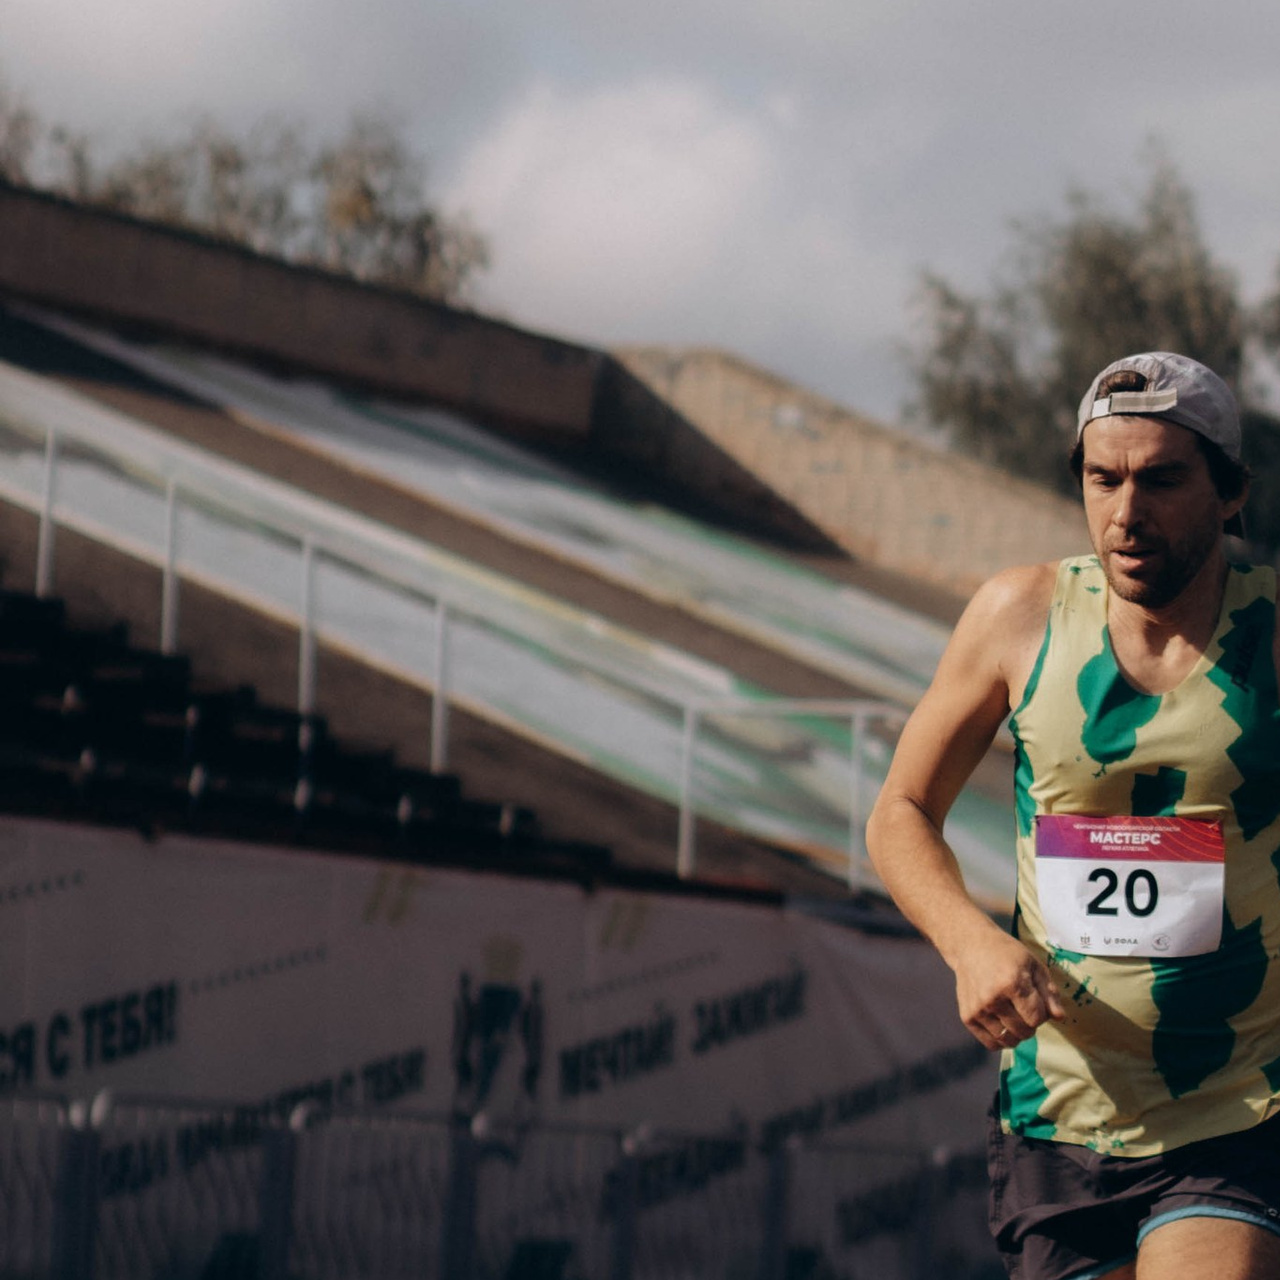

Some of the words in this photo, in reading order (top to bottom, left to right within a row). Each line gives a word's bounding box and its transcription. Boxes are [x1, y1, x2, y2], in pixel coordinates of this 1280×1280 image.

[1090, 832, 1161, 845] МАСТЕРС
[1086, 868, 1159, 917] 20
[46, 1010, 70, 1078] С
[79, 979, 176, 1071] ТЕБЯ!
